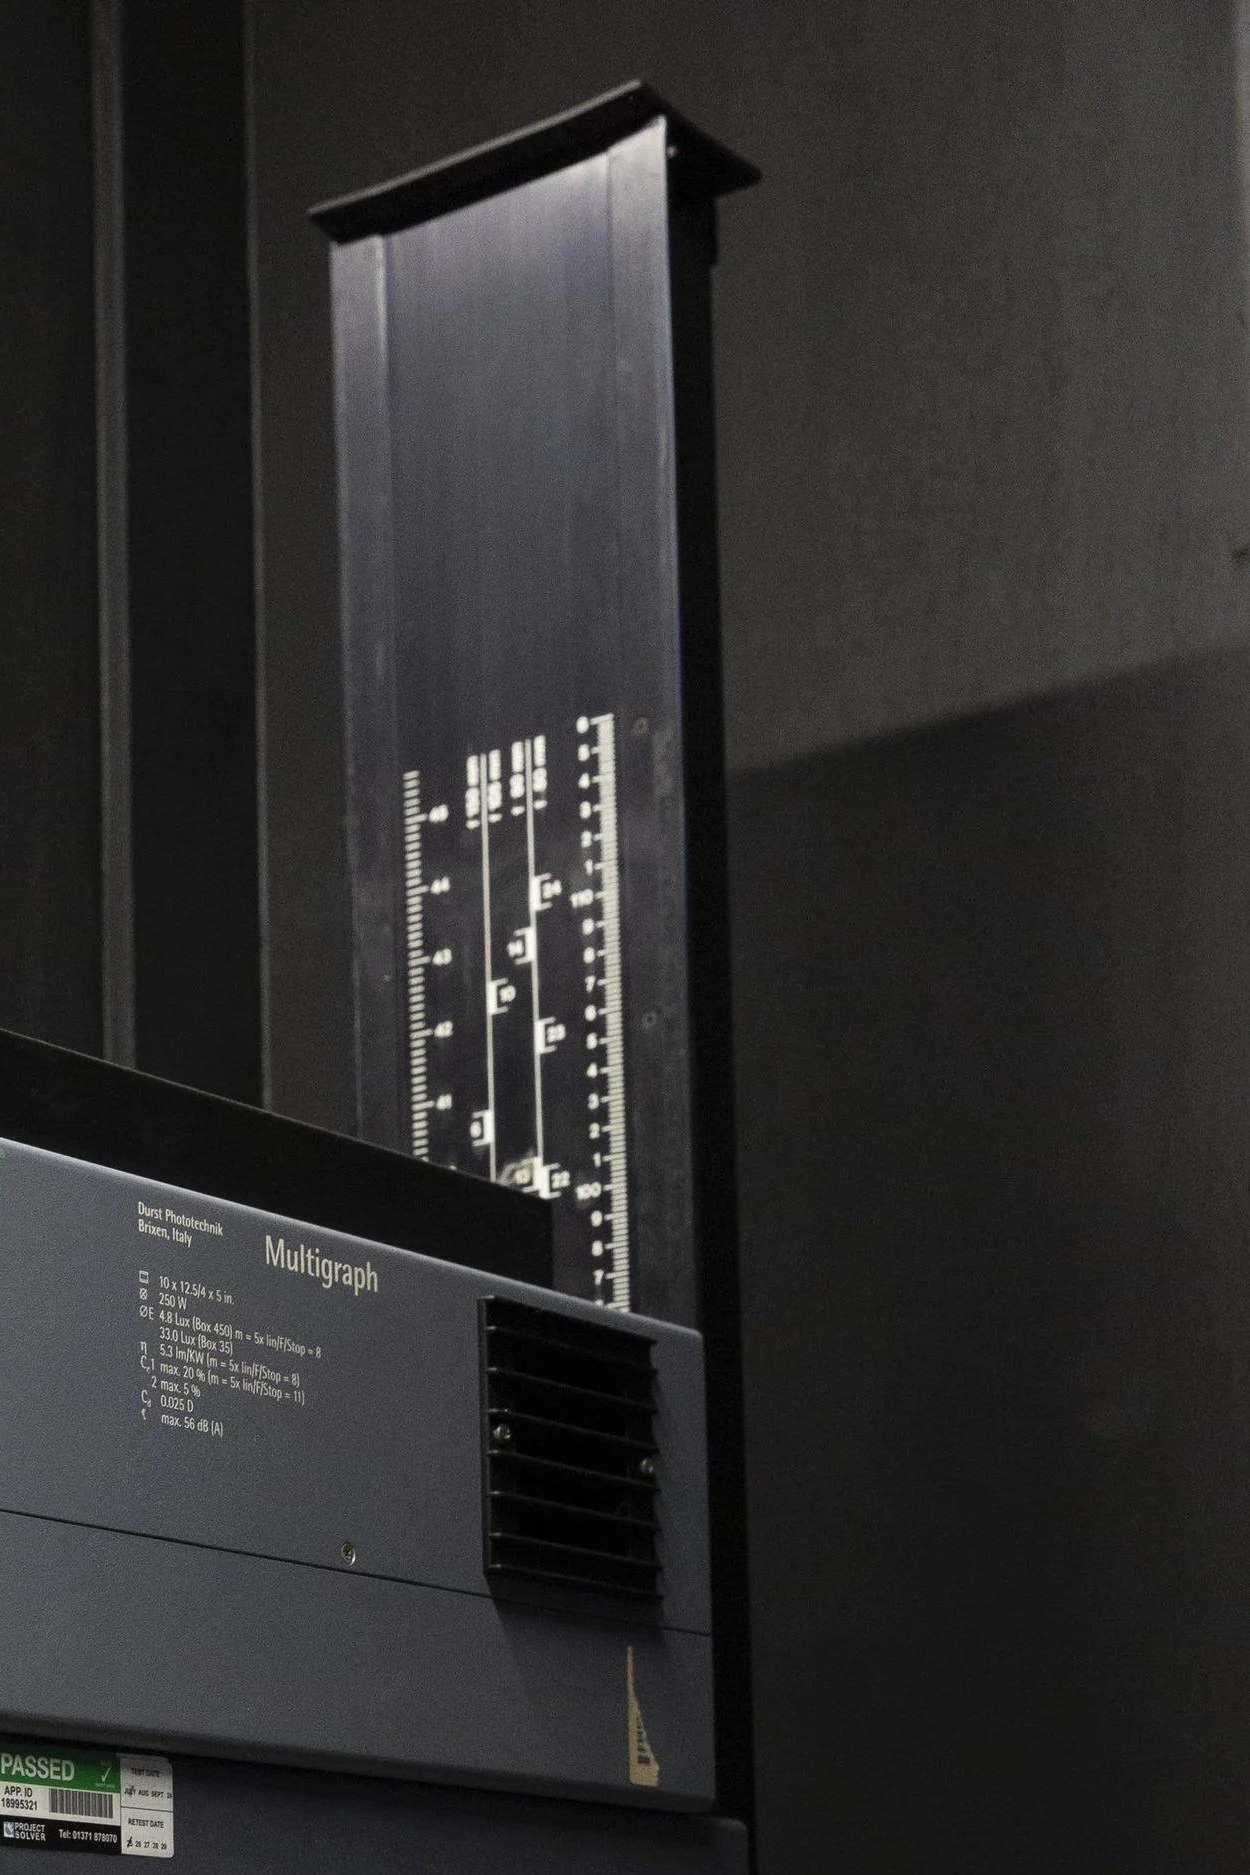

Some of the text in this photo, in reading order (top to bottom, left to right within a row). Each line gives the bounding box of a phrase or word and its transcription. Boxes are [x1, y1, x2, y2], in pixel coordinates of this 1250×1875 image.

[585, 975, 596, 993] 7
[575, 1181, 602, 1200] 100
[138, 1201, 223, 1236] Durst Phototechnik
[138, 1219, 192, 1247] Brixen, Italy
[265, 1235, 379, 1296] Multigraph
[593, 1269, 604, 1285] 7
[159, 1275, 170, 1289] 10
[171, 1281, 177, 1291] x
[180, 1281, 206, 1299] 12.5/4
[208, 1290, 215, 1300] x
[216, 1290, 222, 1303] 5
[159, 1292, 187, 1310] 250 W
[159, 1310, 172, 1324] 4.8
[175, 1313, 190, 1328] Lux
[192, 1315, 212, 1333] (Box
[213, 1322, 233, 1339] 450)
[235, 1330, 243, 1341] m
[254, 1331, 264, 1345] 5x
[315, 1346, 321, 1358] 8
[159, 1327, 233, 1356] 33.0 Lux (Box 35)
[160, 1344, 173, 1358] 5.3
[207, 1353, 219, 1369] (m
[229, 1358, 239, 1374] 5x
[291, 1372, 300, 1388] 8)
[160, 1362, 181, 1377] max.
[183, 1366, 194, 1379] 20
[196, 1368, 206, 1382] %
[208, 1370, 219, 1385] (m
[230, 1375, 240, 1390] 5x
[293, 1389, 305, 1405] 11)
[160, 1379, 182, 1395] max.
[183, 1383, 189, 1396] 5
[190, 1385, 201, 1398] %
[160, 1394, 185, 1411] 0.025
[187, 1399, 194, 1413] D
[161, 1414, 223, 1437] max. 56 dB (A)
[1, 1753, 75, 1781] PASSED
[4, 1785, 32, 1797] APP. ID
[1, 1798, 37, 1811] 18995321
[15, 1822, 45, 1833] PROJECT
[15, 1831, 46, 1842] SOLVER
